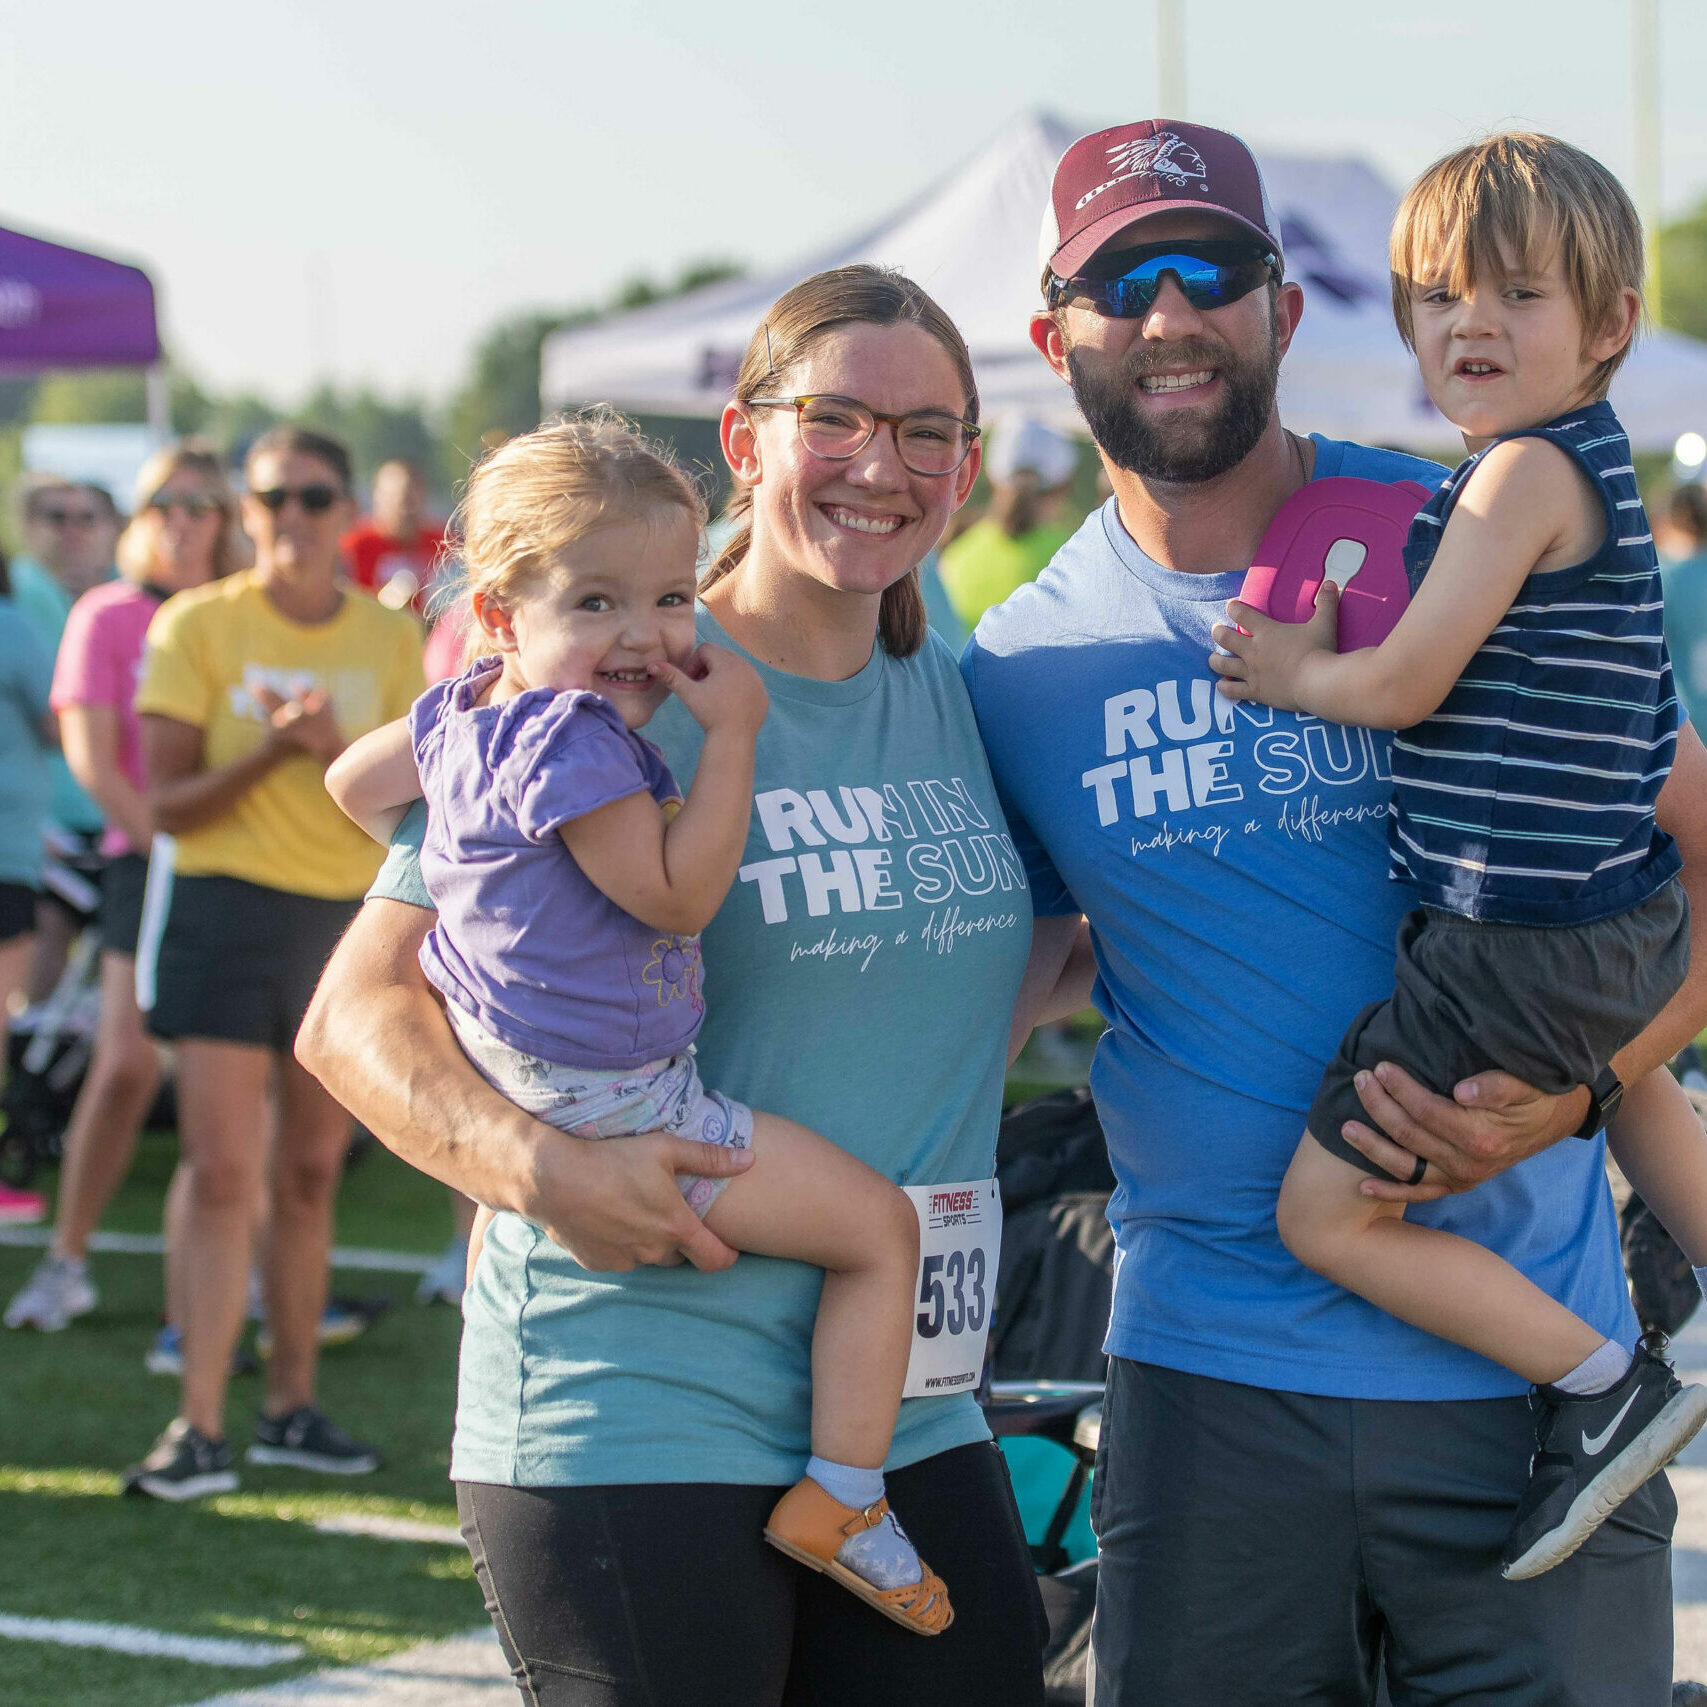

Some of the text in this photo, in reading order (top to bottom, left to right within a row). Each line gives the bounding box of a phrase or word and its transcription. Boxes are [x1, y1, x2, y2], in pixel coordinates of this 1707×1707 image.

[755, 778, 989, 851] RUN IN
[1082, 741, 1243, 827] THE
[1131, 794, 1389, 856] making a differenc
[739, 834, 1026, 924] THE SUN
[790, 905, 1017, 972] making a difference
[933, 1190, 973, 1214] FITNESS
[943, 1213, 967, 1227] SPORTS
[917, 1248, 986, 1338] 533
